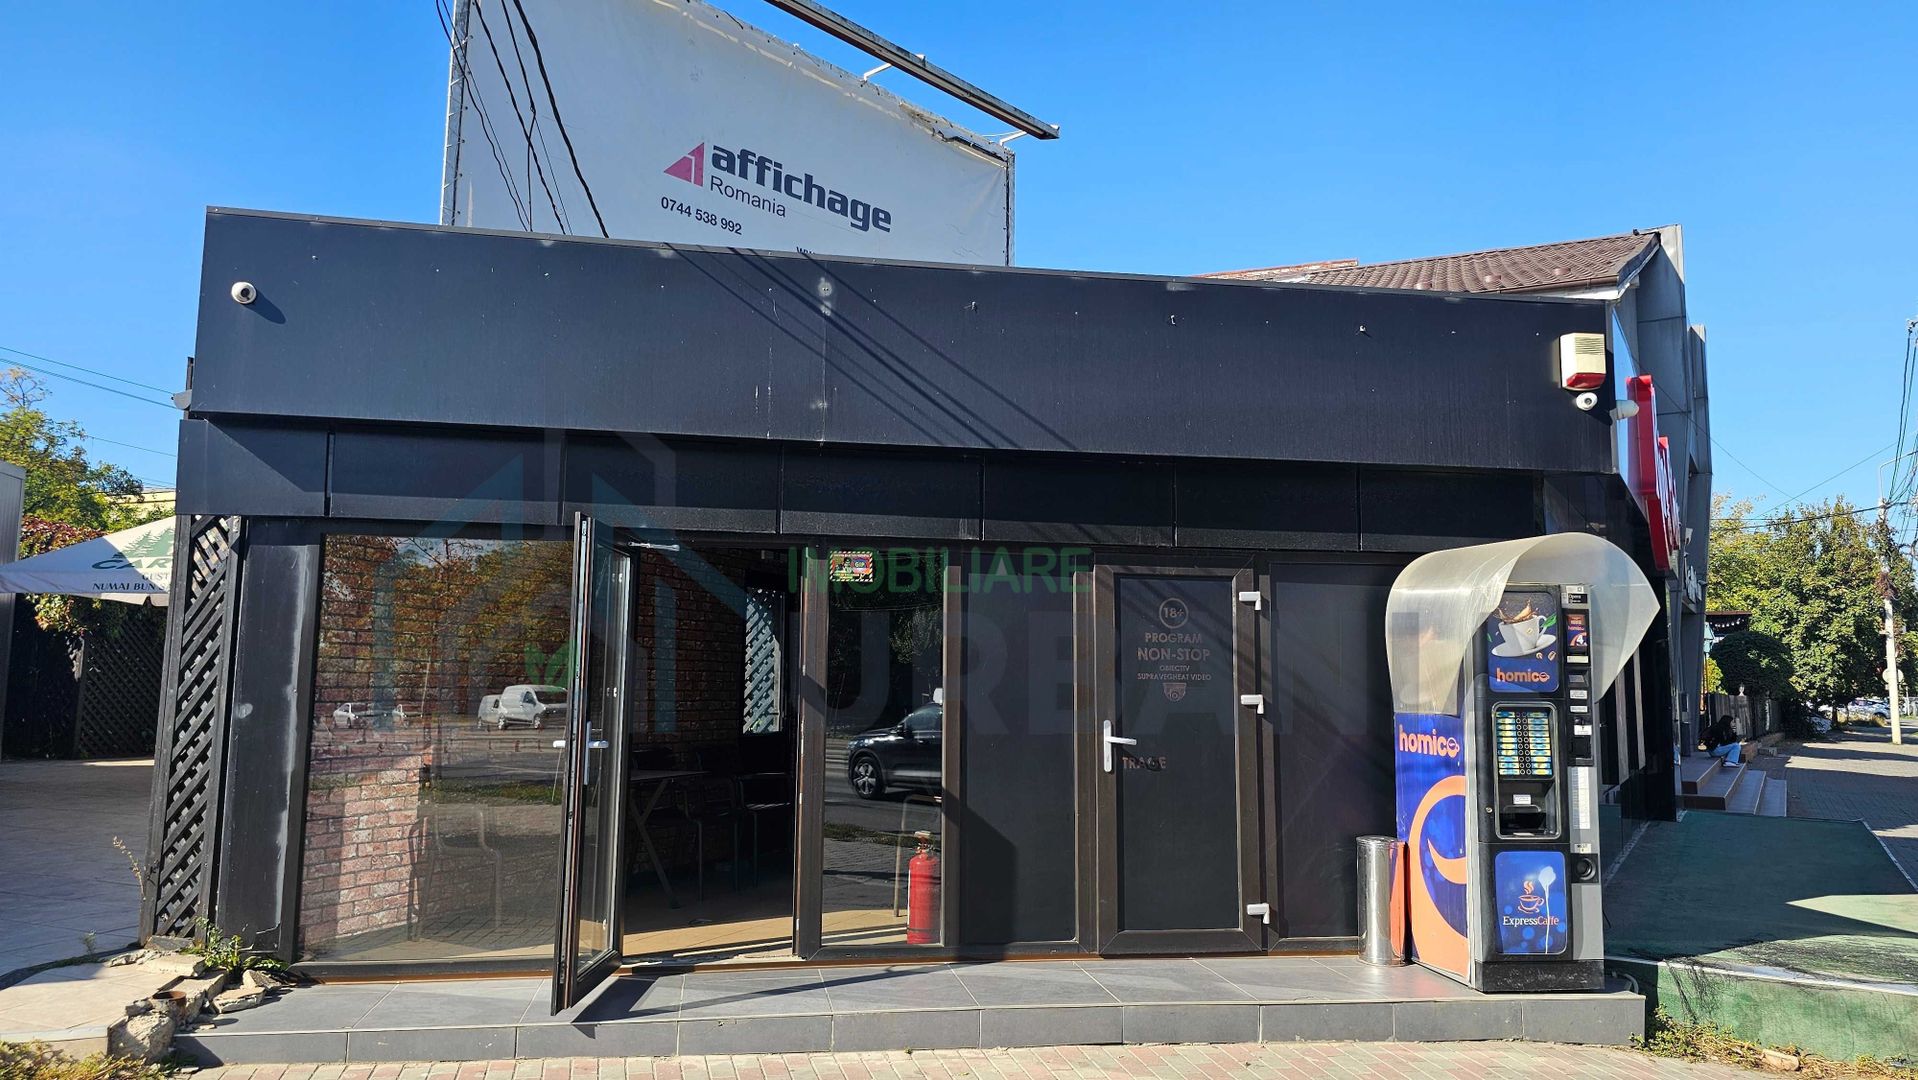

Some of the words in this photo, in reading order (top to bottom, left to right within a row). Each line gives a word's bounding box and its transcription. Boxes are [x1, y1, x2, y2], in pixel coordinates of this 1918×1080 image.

[710, 175, 786, 217] Romania
[711, 144, 892, 233] affichage
[660, 196, 692, 218] 0744
[694, 208, 718, 226] 538
[720, 217, 743, 235] 992
[92, 582, 130, 591] NUMAI
[133, 582, 156, 591] BUN
[1163, 607, 1184, 618] 18+
[1144, 632, 1203, 643] PROGRAM
[1137, 647, 1211, 662] NON-STOP
[1137, 673, 1190, 681] SUPRAVEGHEAT
[1496, 667, 1550, 684] homico
[1399, 724, 1460, 758] homico
